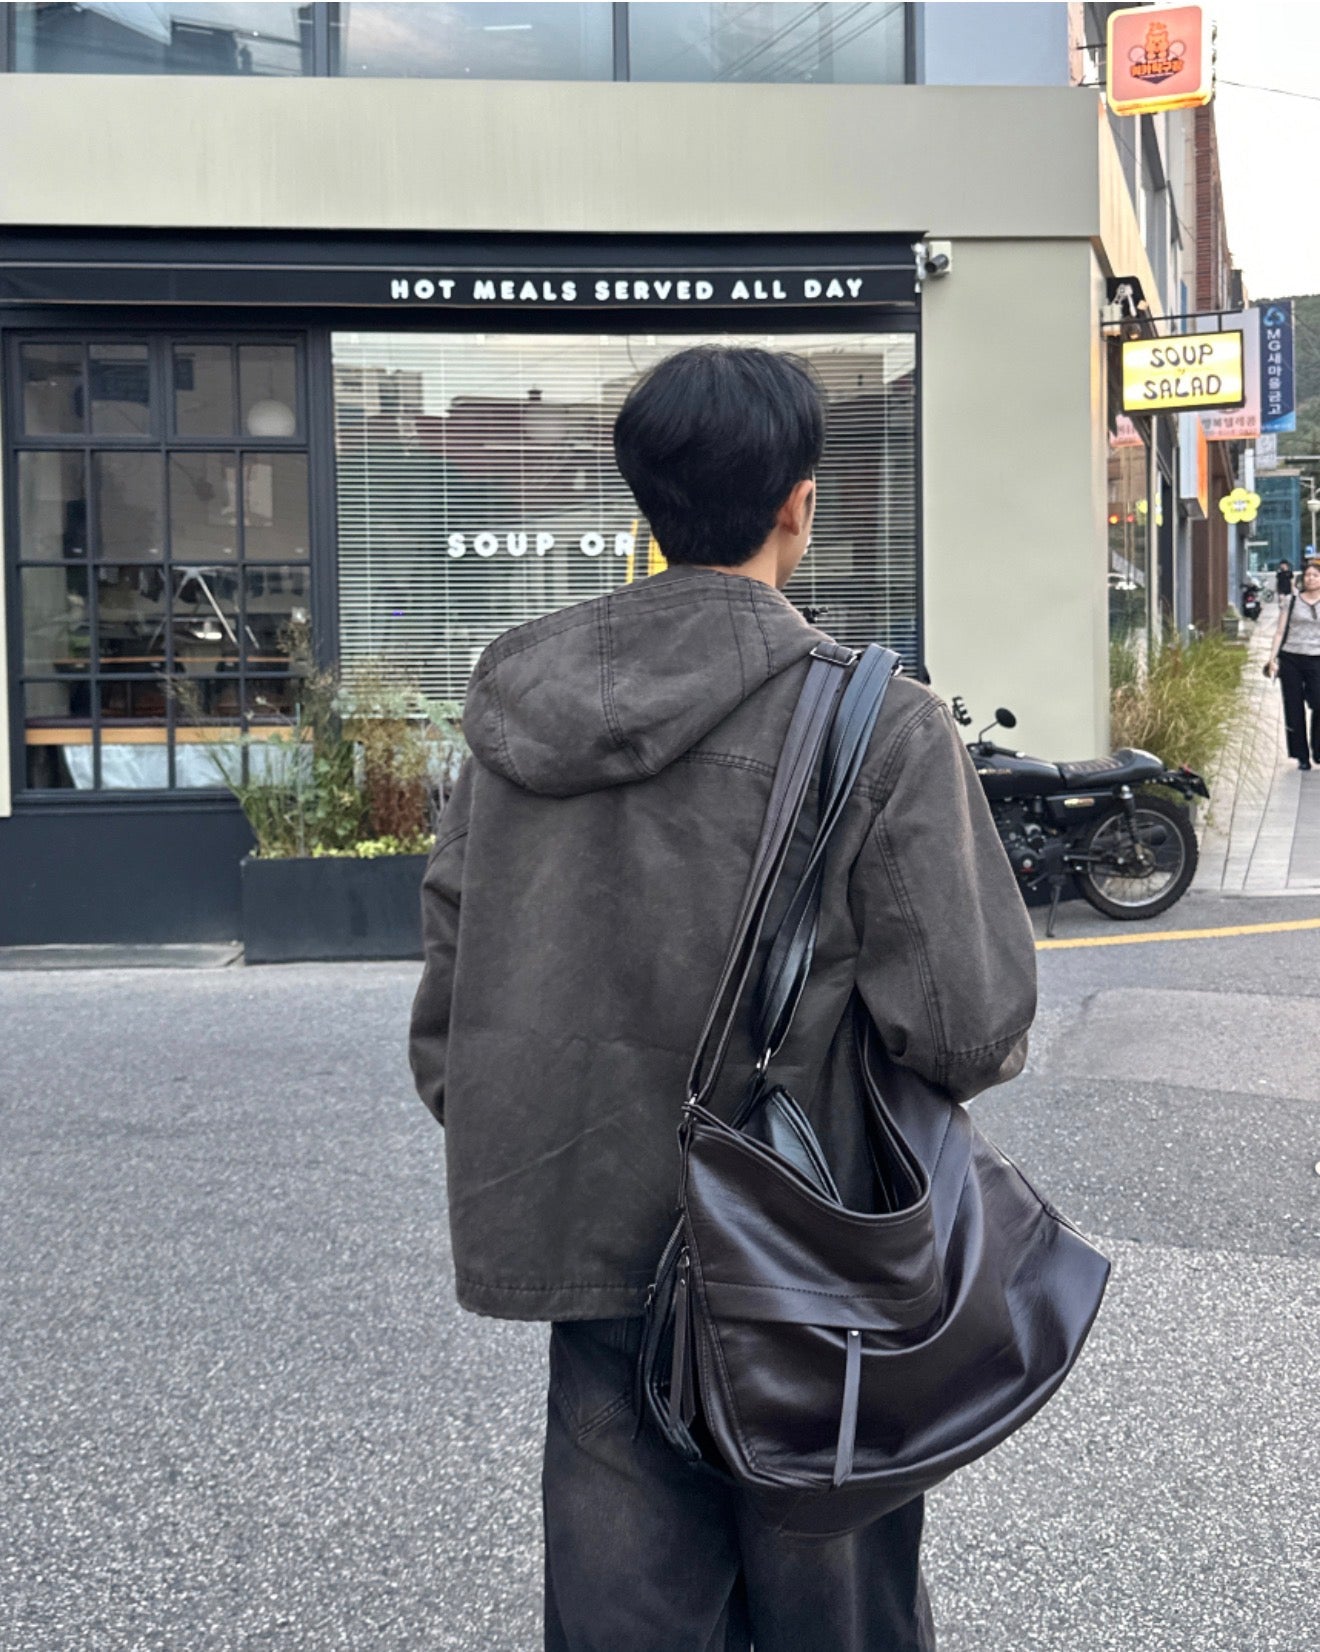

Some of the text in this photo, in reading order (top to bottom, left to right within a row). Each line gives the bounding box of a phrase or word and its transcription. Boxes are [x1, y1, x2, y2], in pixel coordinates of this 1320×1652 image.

[391, 278, 863, 301] HOT MEALS SERVED ALL DAY
[1150, 343, 1213, 368] SOUP
[1143, 374, 1222, 400] SALAD
[447, 532, 635, 557] SOUP OR
